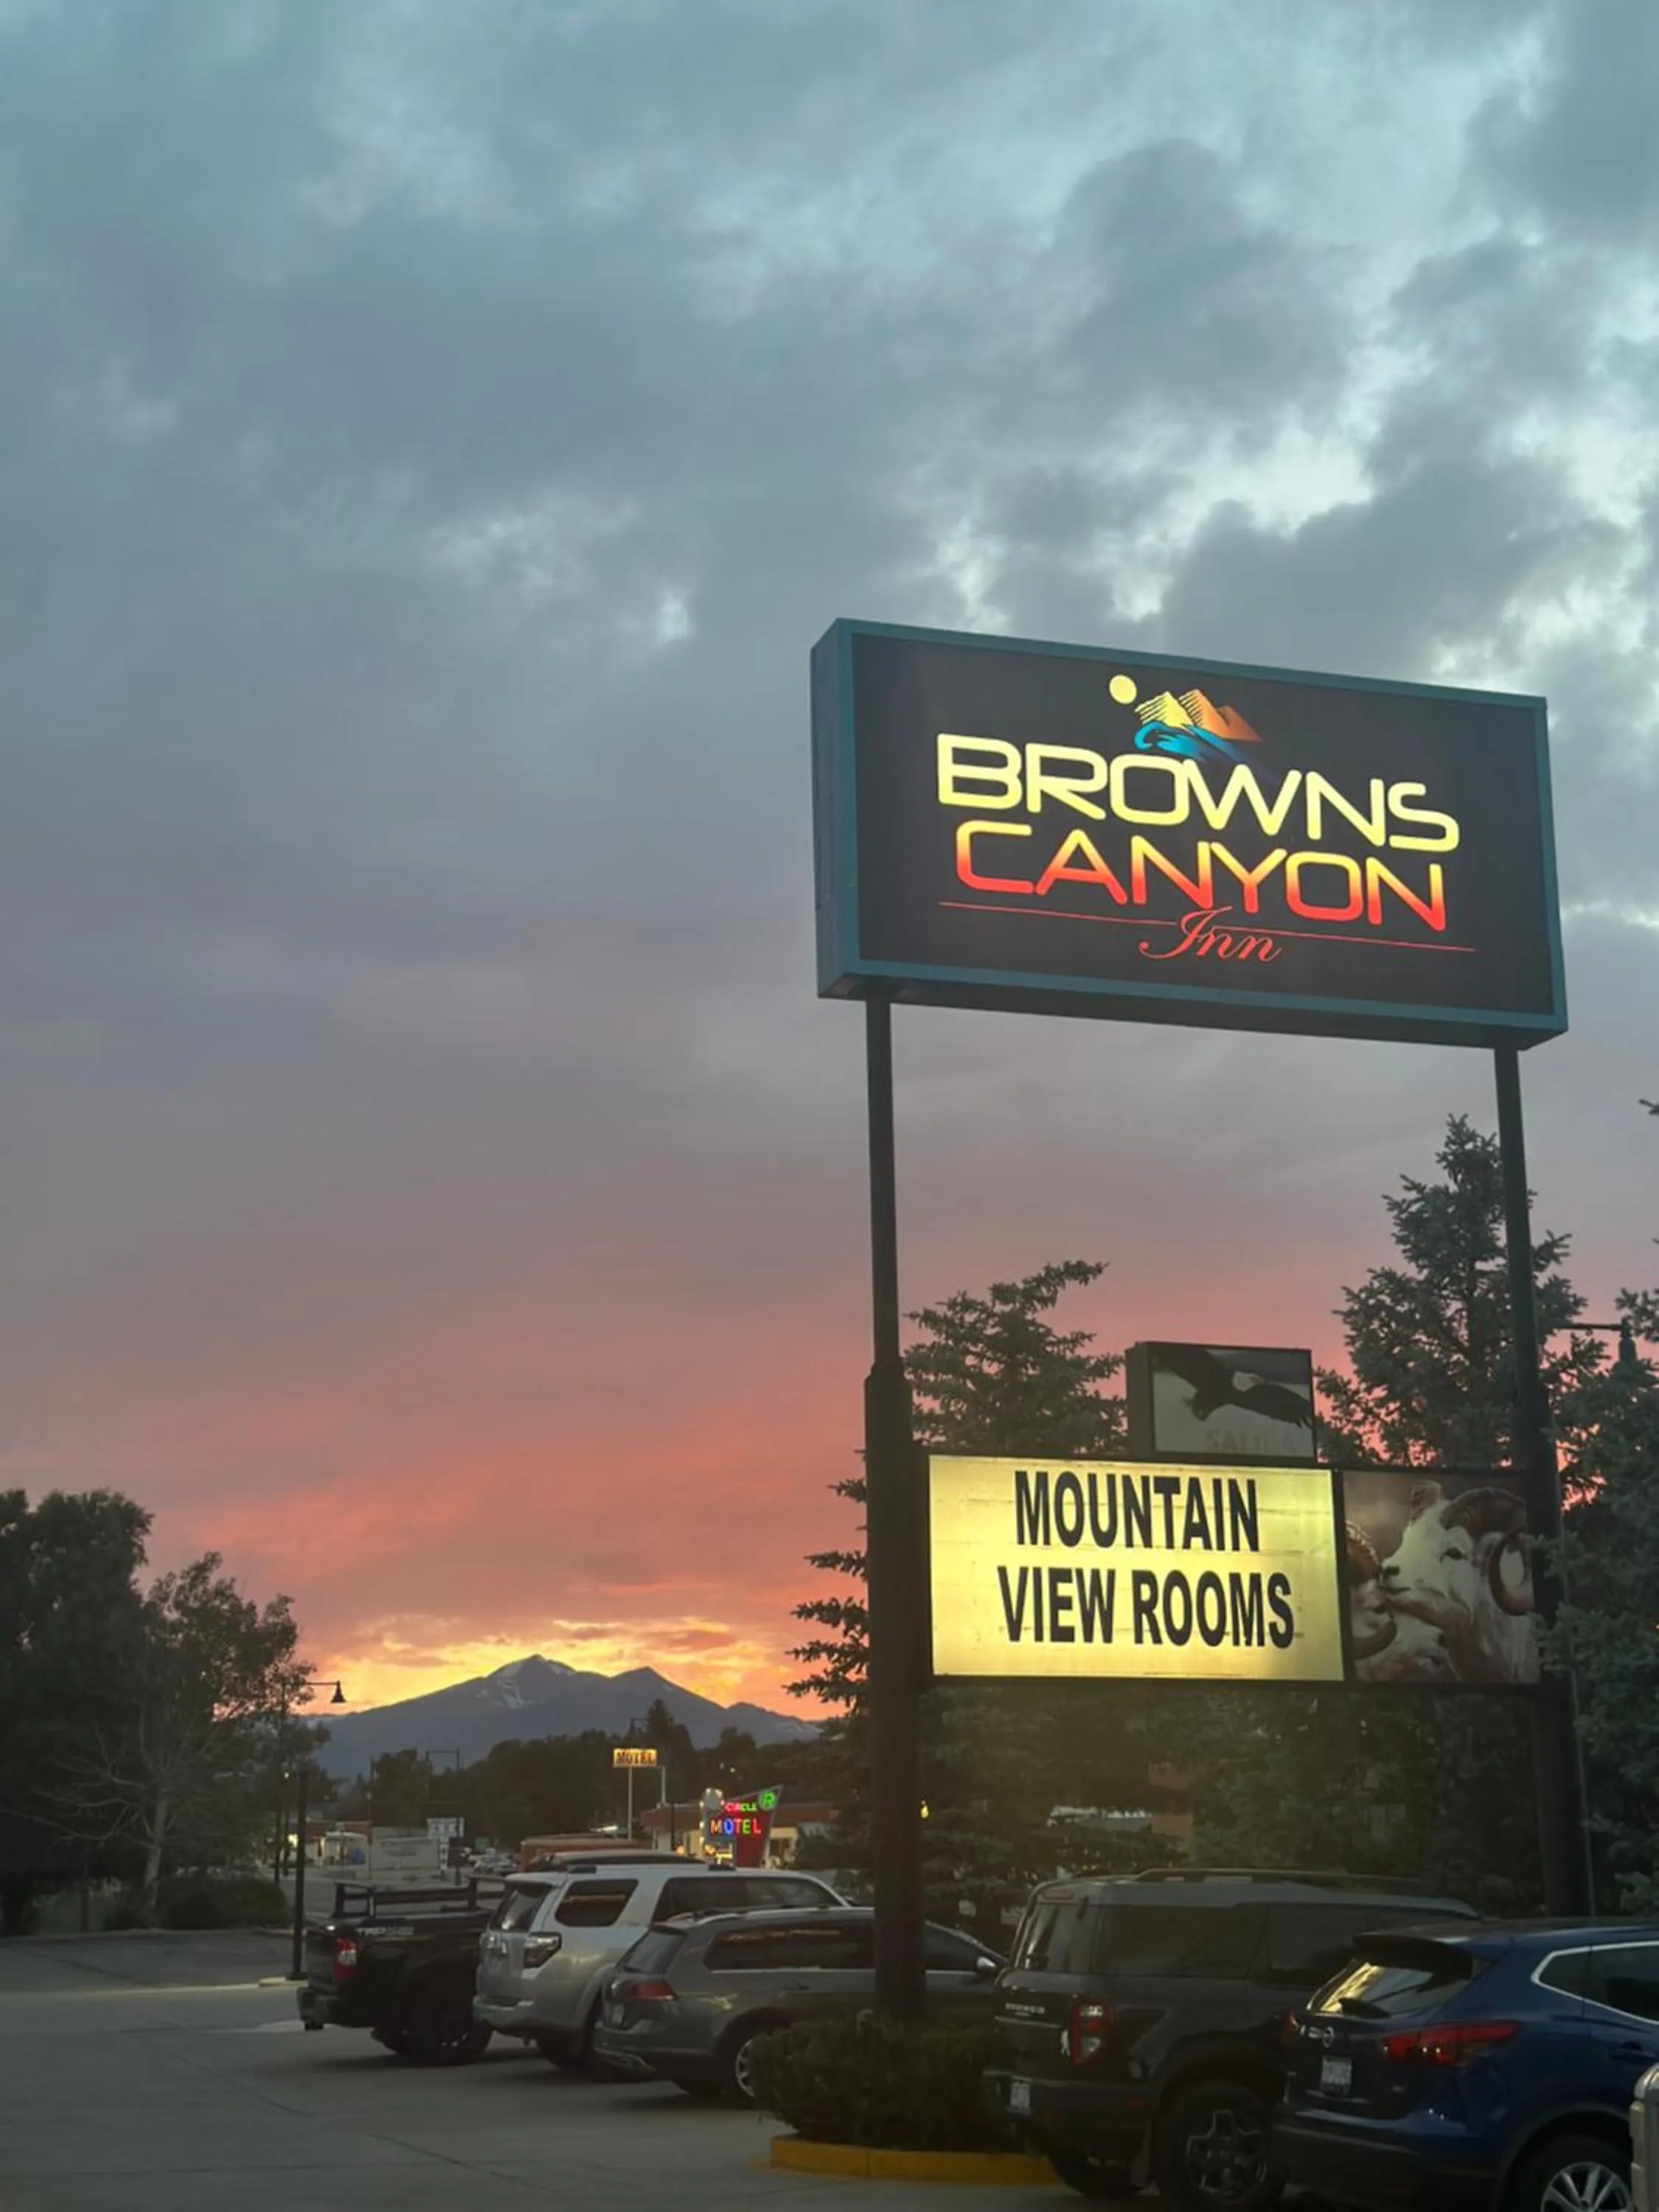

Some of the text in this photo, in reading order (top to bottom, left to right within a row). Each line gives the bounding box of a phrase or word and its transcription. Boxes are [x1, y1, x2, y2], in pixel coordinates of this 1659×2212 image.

[937, 733, 1459, 852] BROWNS
[956, 820, 1446, 932] CANYON
[1138, 906, 1281, 961] Inn
[1014, 1470, 1260, 1552] MOUNTAIN
[997, 1565, 1295, 1649] VIEW ROOMS
[710, 1818, 762, 1835] MOTEL
